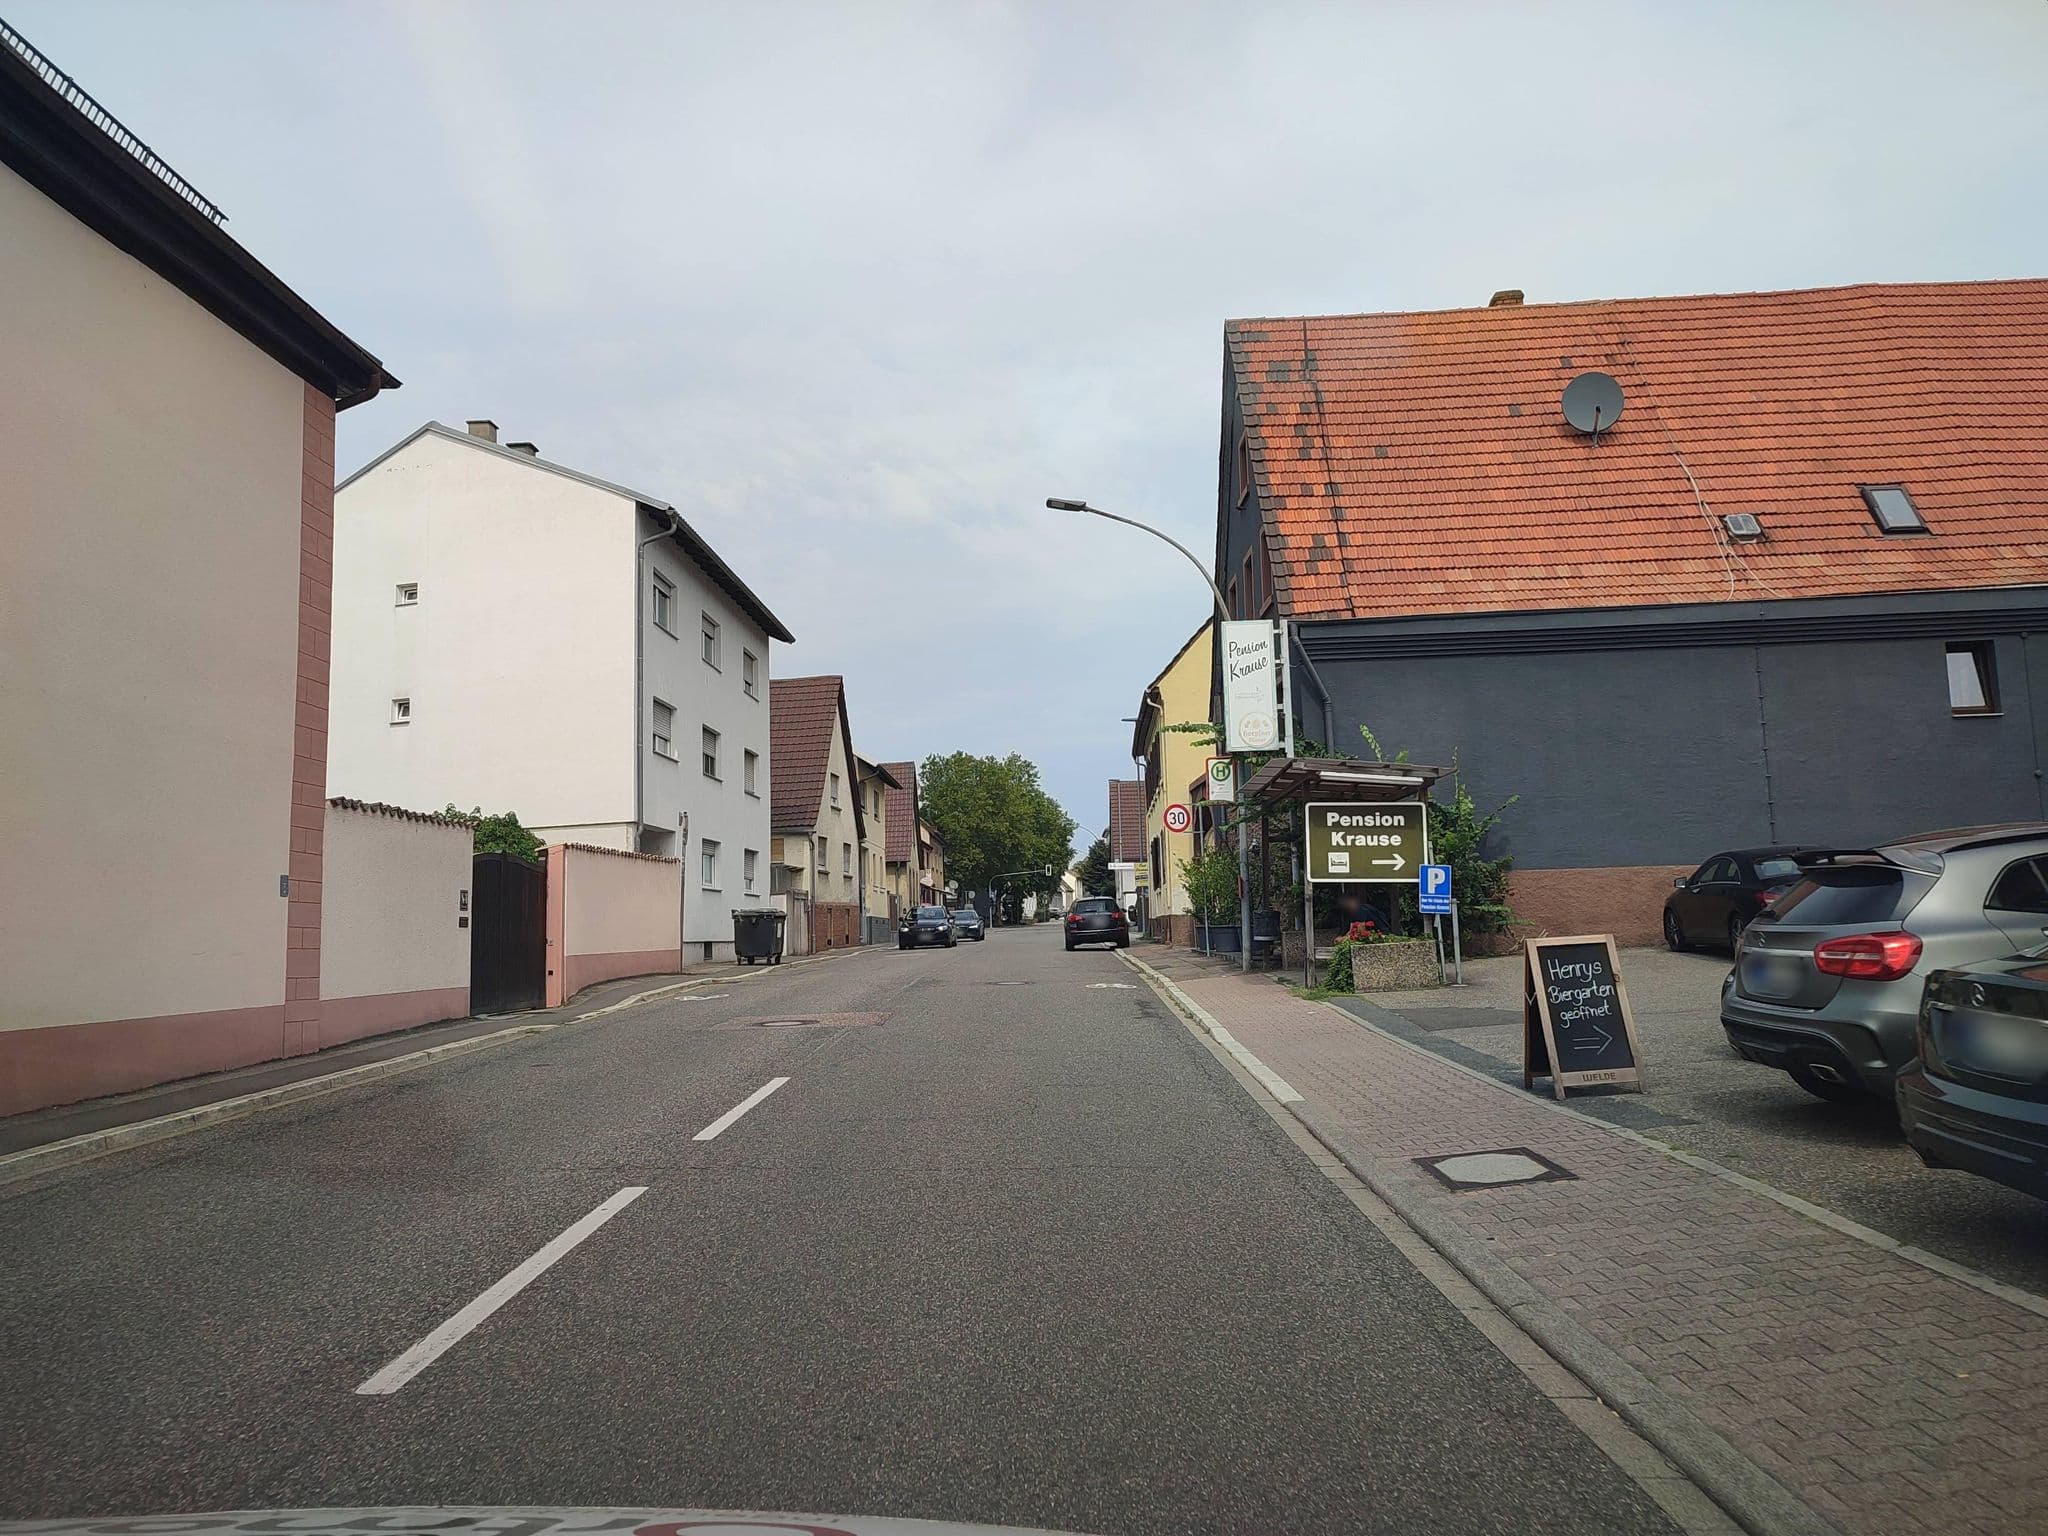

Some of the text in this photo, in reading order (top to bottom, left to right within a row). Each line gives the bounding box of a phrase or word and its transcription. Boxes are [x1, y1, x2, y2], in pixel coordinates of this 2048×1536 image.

[1229, 640, 1269, 659] Pension
[1229, 656, 1269, 682] Krause
[1215, 765, 1226, 778] H
[1169, 811, 1186, 825] 30
[1326, 811, 1406, 827] Pension
[1331, 831, 1403, 847] Krause
[1427, 867, 1446, 894] P
[1547, 958, 1603, 983] Henrys
[1548, 980, 1616, 1006] Biergarten
[1582, 1071, 1617, 1082] WELDE
